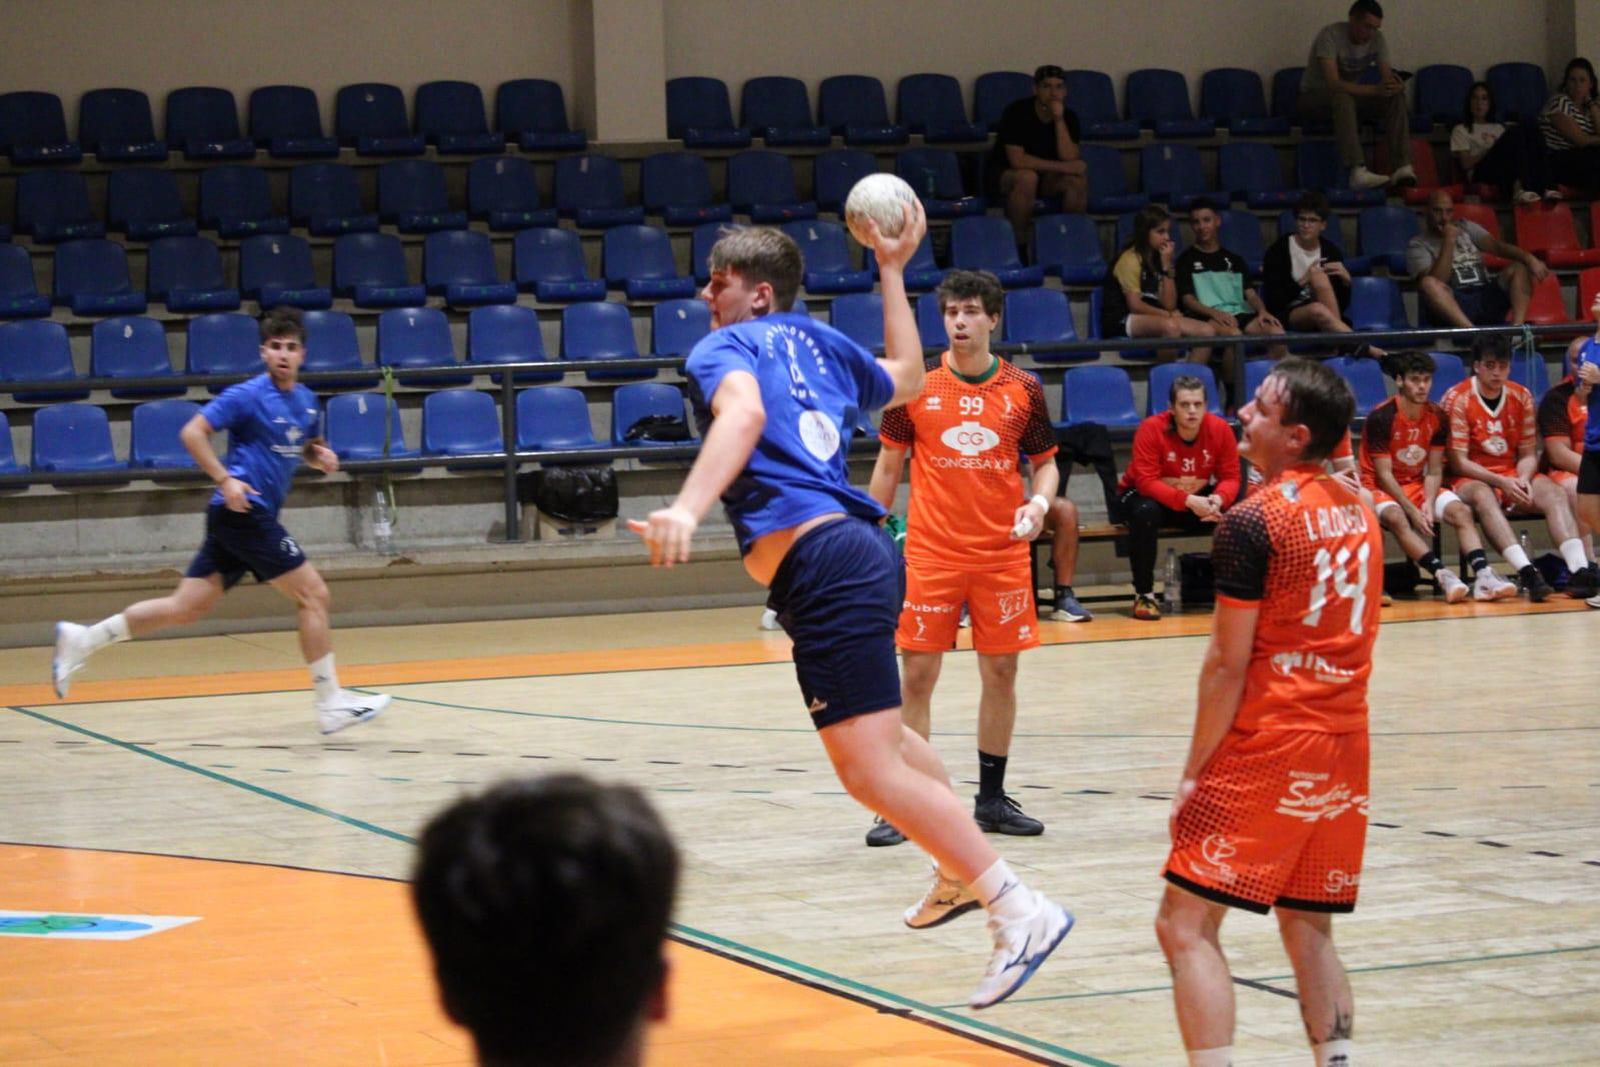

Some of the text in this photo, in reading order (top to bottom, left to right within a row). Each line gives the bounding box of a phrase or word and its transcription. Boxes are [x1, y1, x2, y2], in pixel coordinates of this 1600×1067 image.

[959, 395, 985, 416] 99
[957, 431, 985, 446] CG
[1407, 428, 1420, 441] 77
[1181, 457, 1196, 473] 31
[1302, 541, 1371, 636] 14
